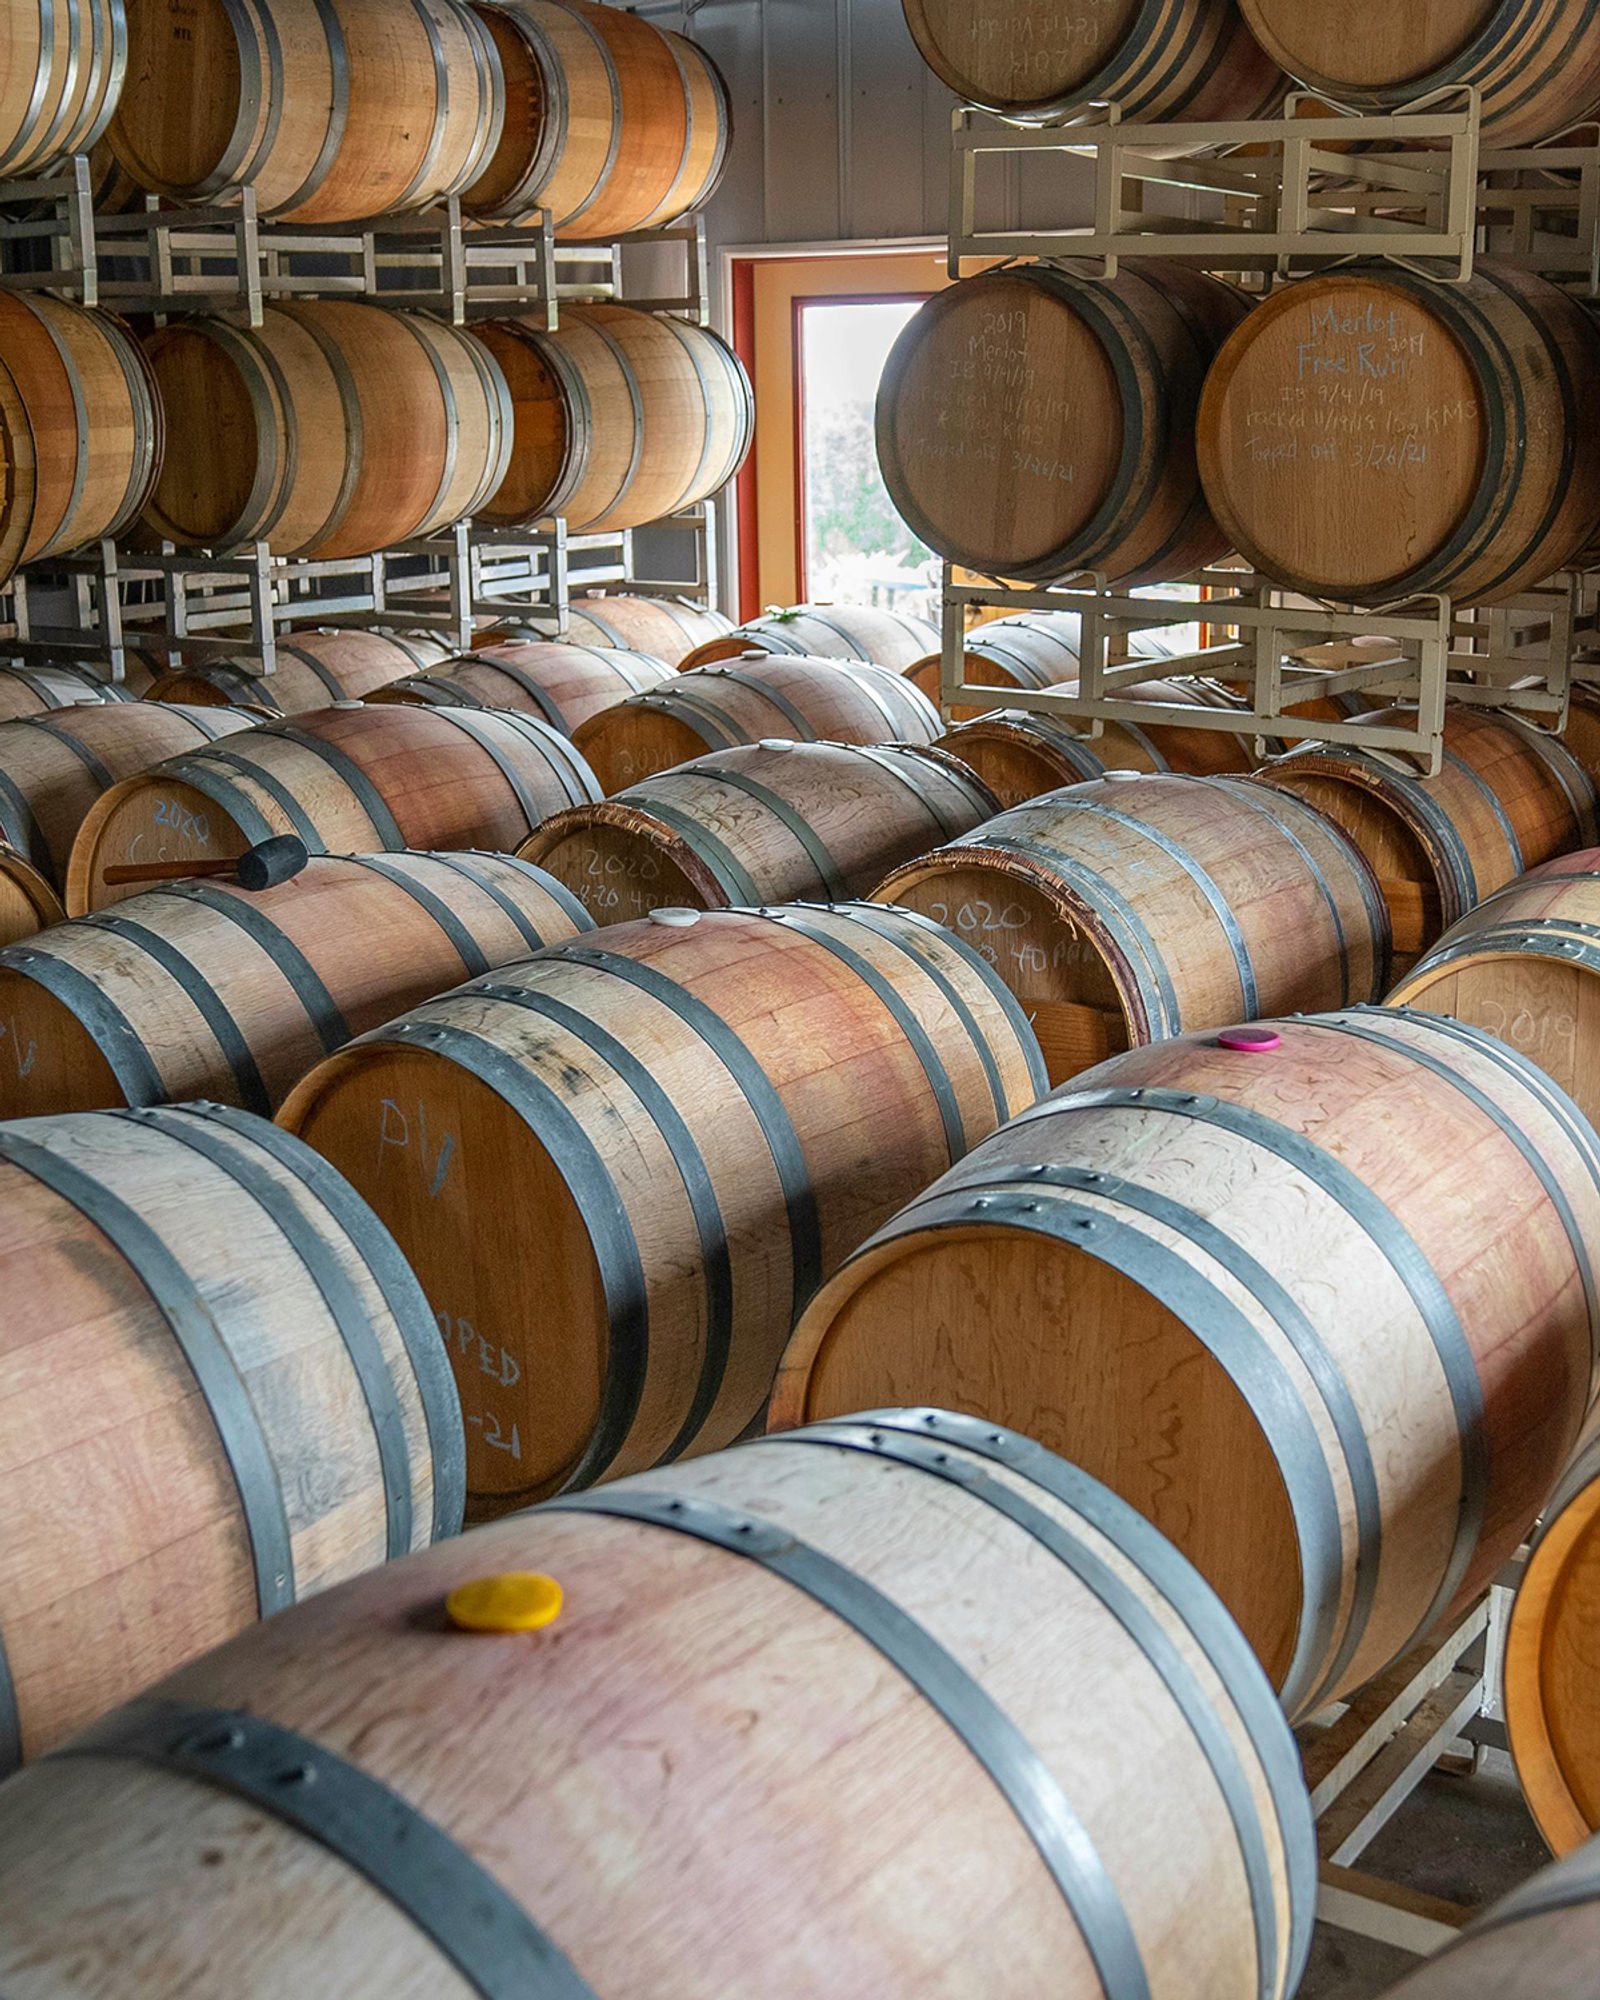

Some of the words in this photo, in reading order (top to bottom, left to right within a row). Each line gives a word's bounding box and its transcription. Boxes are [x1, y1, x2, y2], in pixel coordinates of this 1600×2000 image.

[1039, 16, 1100, 46] Petit
[983, 310, 1027, 340] 2019
[1310, 303, 1402, 338] Merlot
[968, 334, 1029, 362] Merlot
[1295, 341, 1349, 381] Free
[1357, 341, 1408, 379] Run
[585, 849, 661, 880] 2020
[567, 884, 620, 908] -8-20
[930, 900, 1032, 931] 2020
[1010, 942, 1047, 973] 40
[0, 1014, 38, 1080] V
[1480, 999, 1576, 1076] 2019
